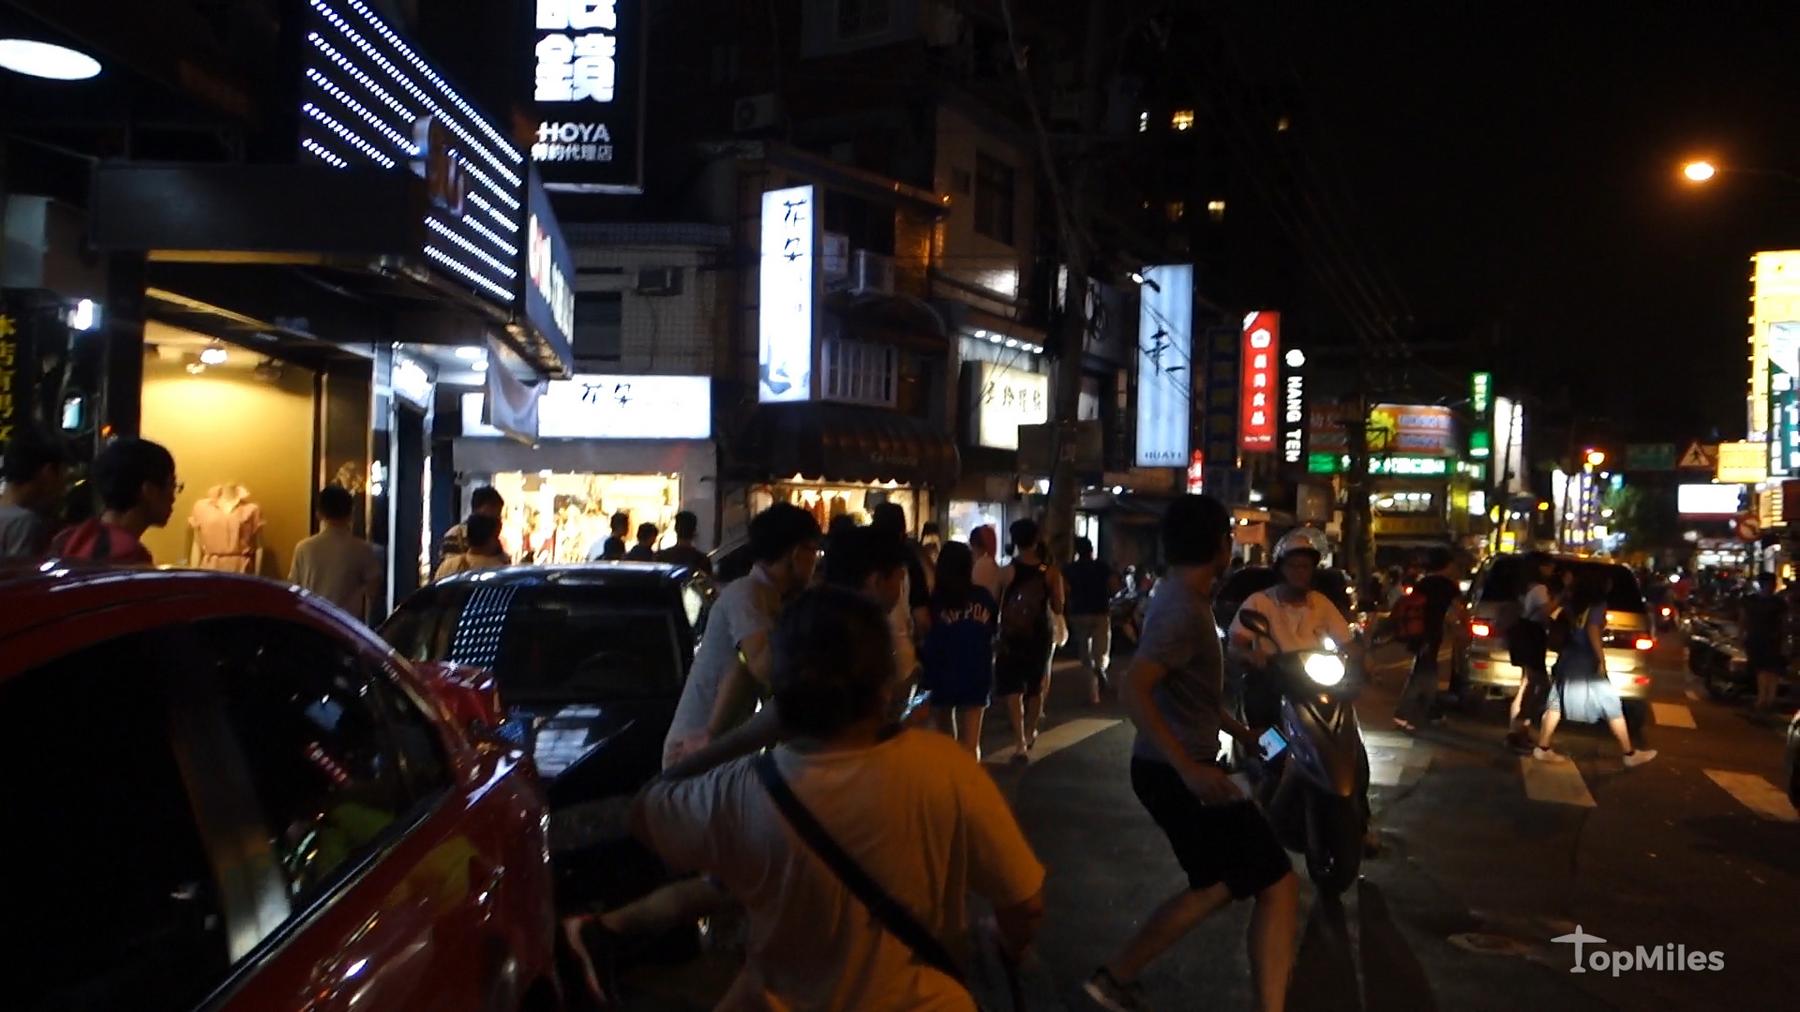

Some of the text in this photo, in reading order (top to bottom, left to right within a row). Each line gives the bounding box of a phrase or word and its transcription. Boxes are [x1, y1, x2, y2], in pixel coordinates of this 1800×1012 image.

[535, 121, 611, 143] HOYA
[1284, 375, 1304, 463] HANG TEN
